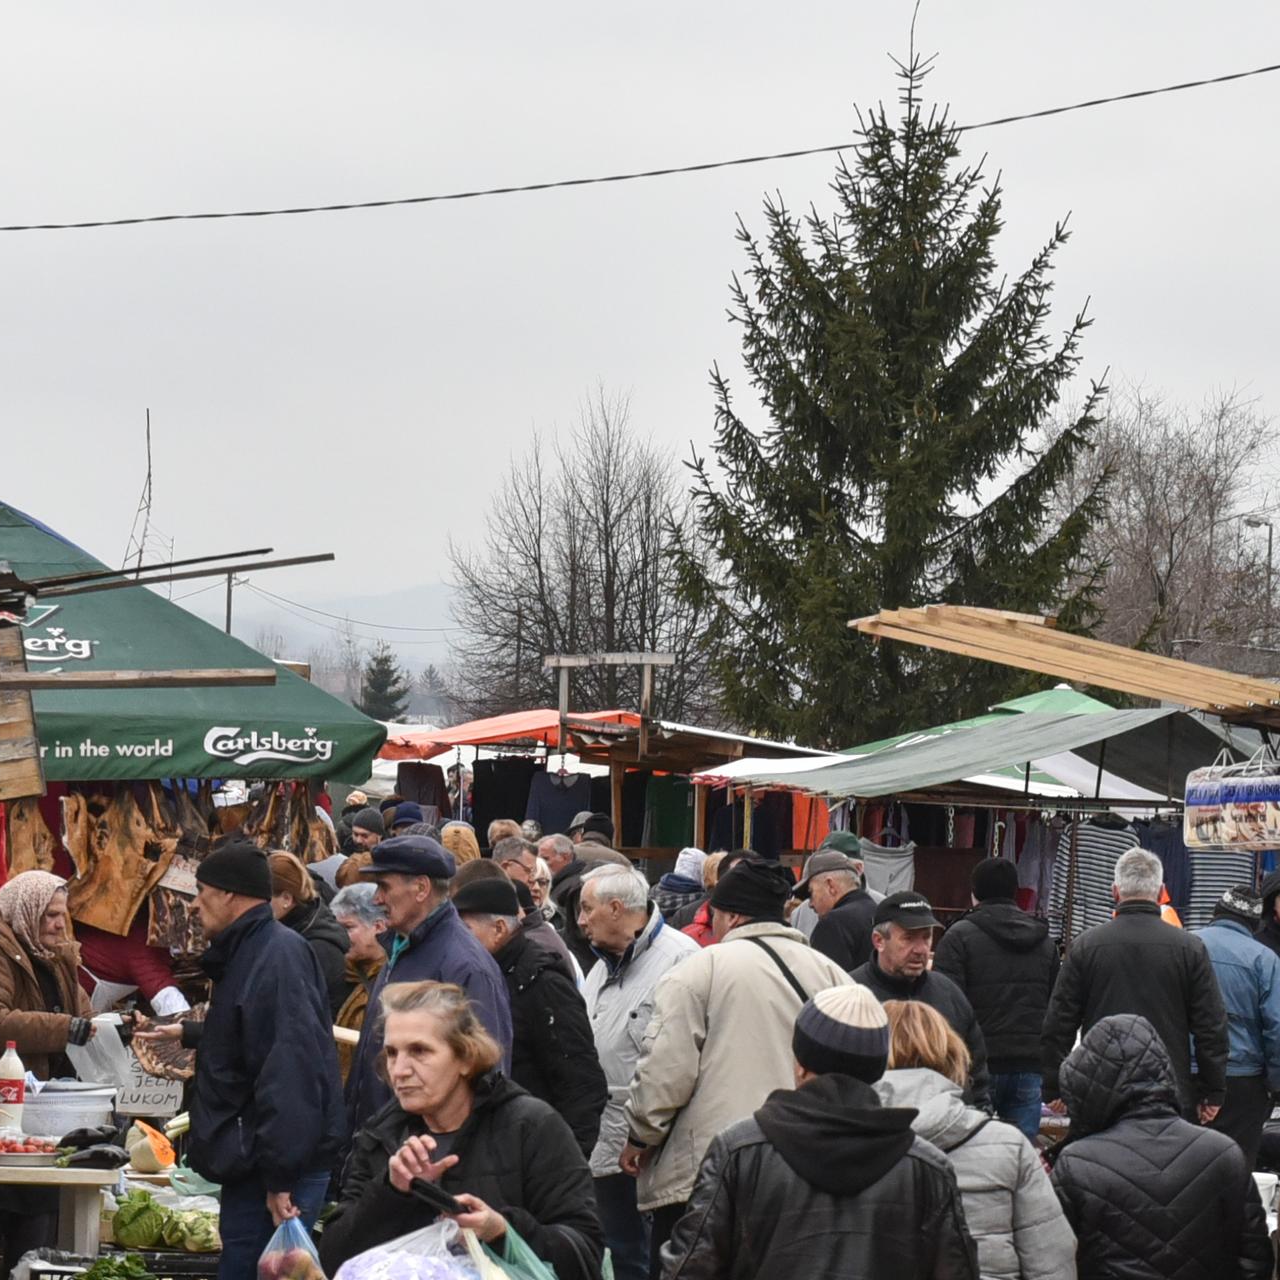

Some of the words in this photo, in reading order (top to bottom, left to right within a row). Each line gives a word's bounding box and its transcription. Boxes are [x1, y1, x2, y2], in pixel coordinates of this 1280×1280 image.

[55, 740, 73, 759] in
[79, 738, 110, 758] the
[115, 739, 174, 758] world
[203, 726, 333, 766] Carlsberg
[119, 1090, 178, 1108] LUKOM
